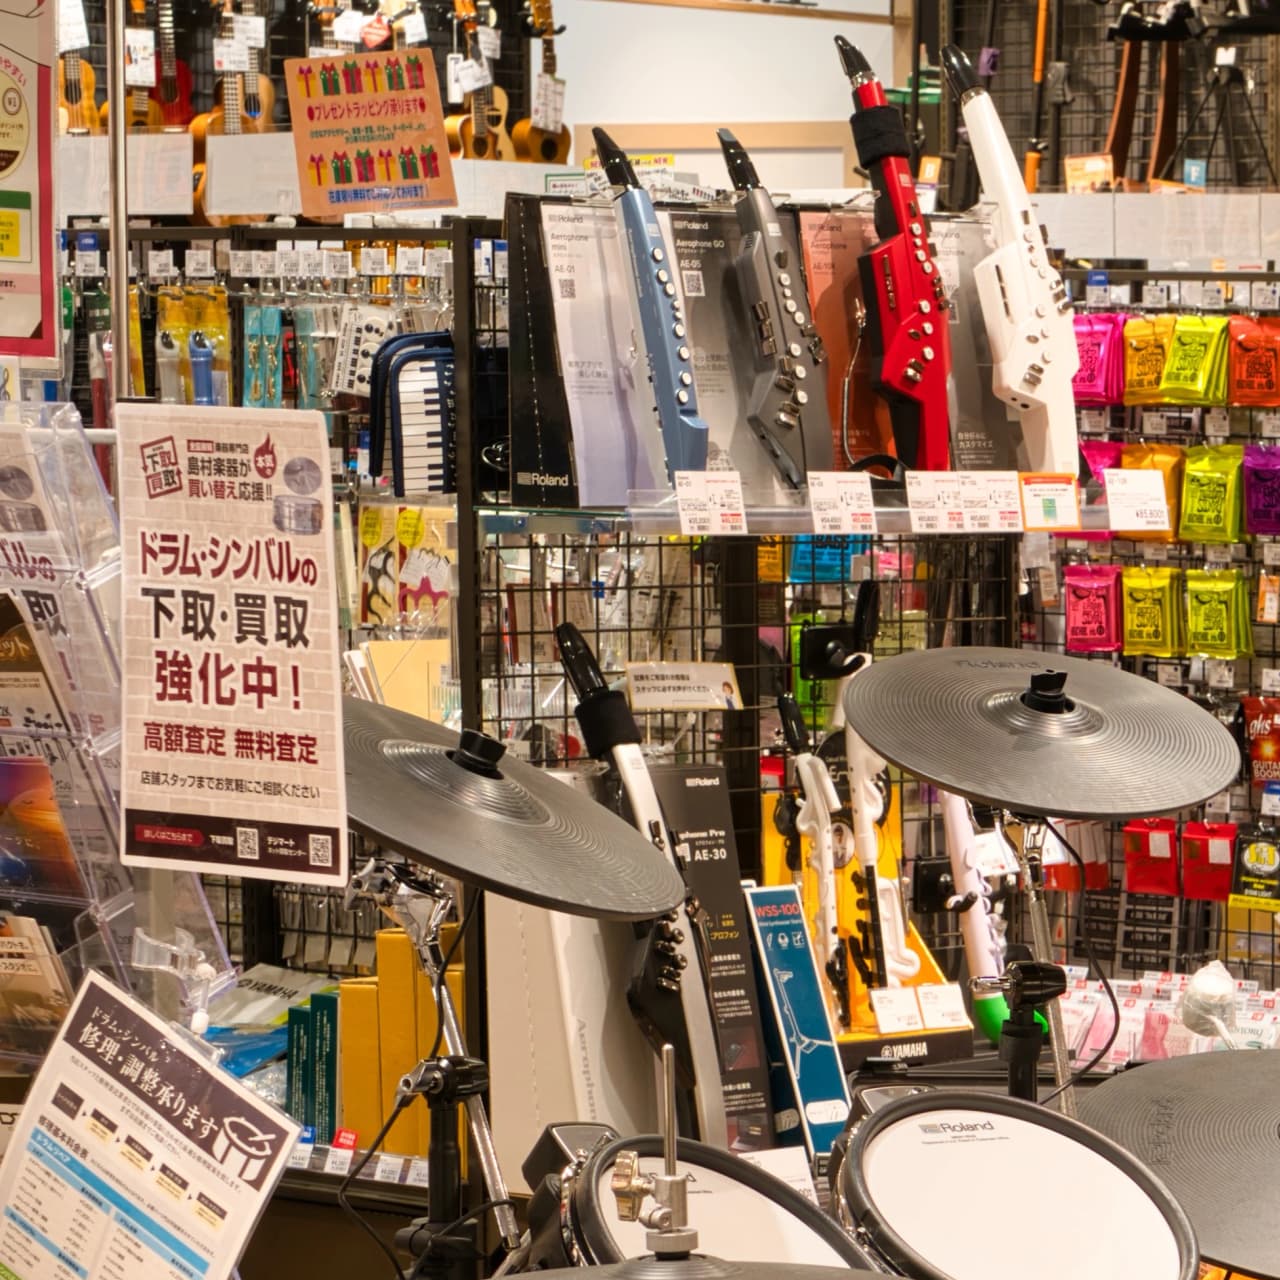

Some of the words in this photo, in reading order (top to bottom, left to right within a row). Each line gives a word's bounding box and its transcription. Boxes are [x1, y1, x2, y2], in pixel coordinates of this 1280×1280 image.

[559, 215, 583, 225] Roland
[683, 222, 708, 232] Roland
[551, 233, 588, 243] Aerophone
[676, 239, 713, 249] Aerophone
[552, 244, 567, 252] mini
[555, 264, 575, 273] AE-01
[680, 259, 701, 268] AE-05
[147, 449, 177, 473] 下取
[187, 457, 251, 478] 島村楽器が
[150, 468, 178, 492] 買取
[532, 473, 569, 488] Roland
[140, 531, 318, 586] ドラム・シンバルの
[140, 587, 310, 649] 下取・買取
[156, 650, 302, 711] 強化中!
[1250, 713, 1272, 740] ghs
[143, 721, 227, 757] 高額査定
[234, 728, 319, 765] 無料査定
[140, 771, 320, 799] 店舗スタッフまでお気軽にご相談ください
[695, 776, 719, 787] Roland
[708, 829, 726, 839] Pro
[694, 848, 727, 862] AE-30
[754, 903, 800, 918] WSS-100
[249, 980, 300, 1000] YAMAHA
[892, 1041, 928, 1057] YAMAHA
[79, 1021, 219, 1140] 修理・調整承ります
[940, 1120, 995, 1133] Roland
